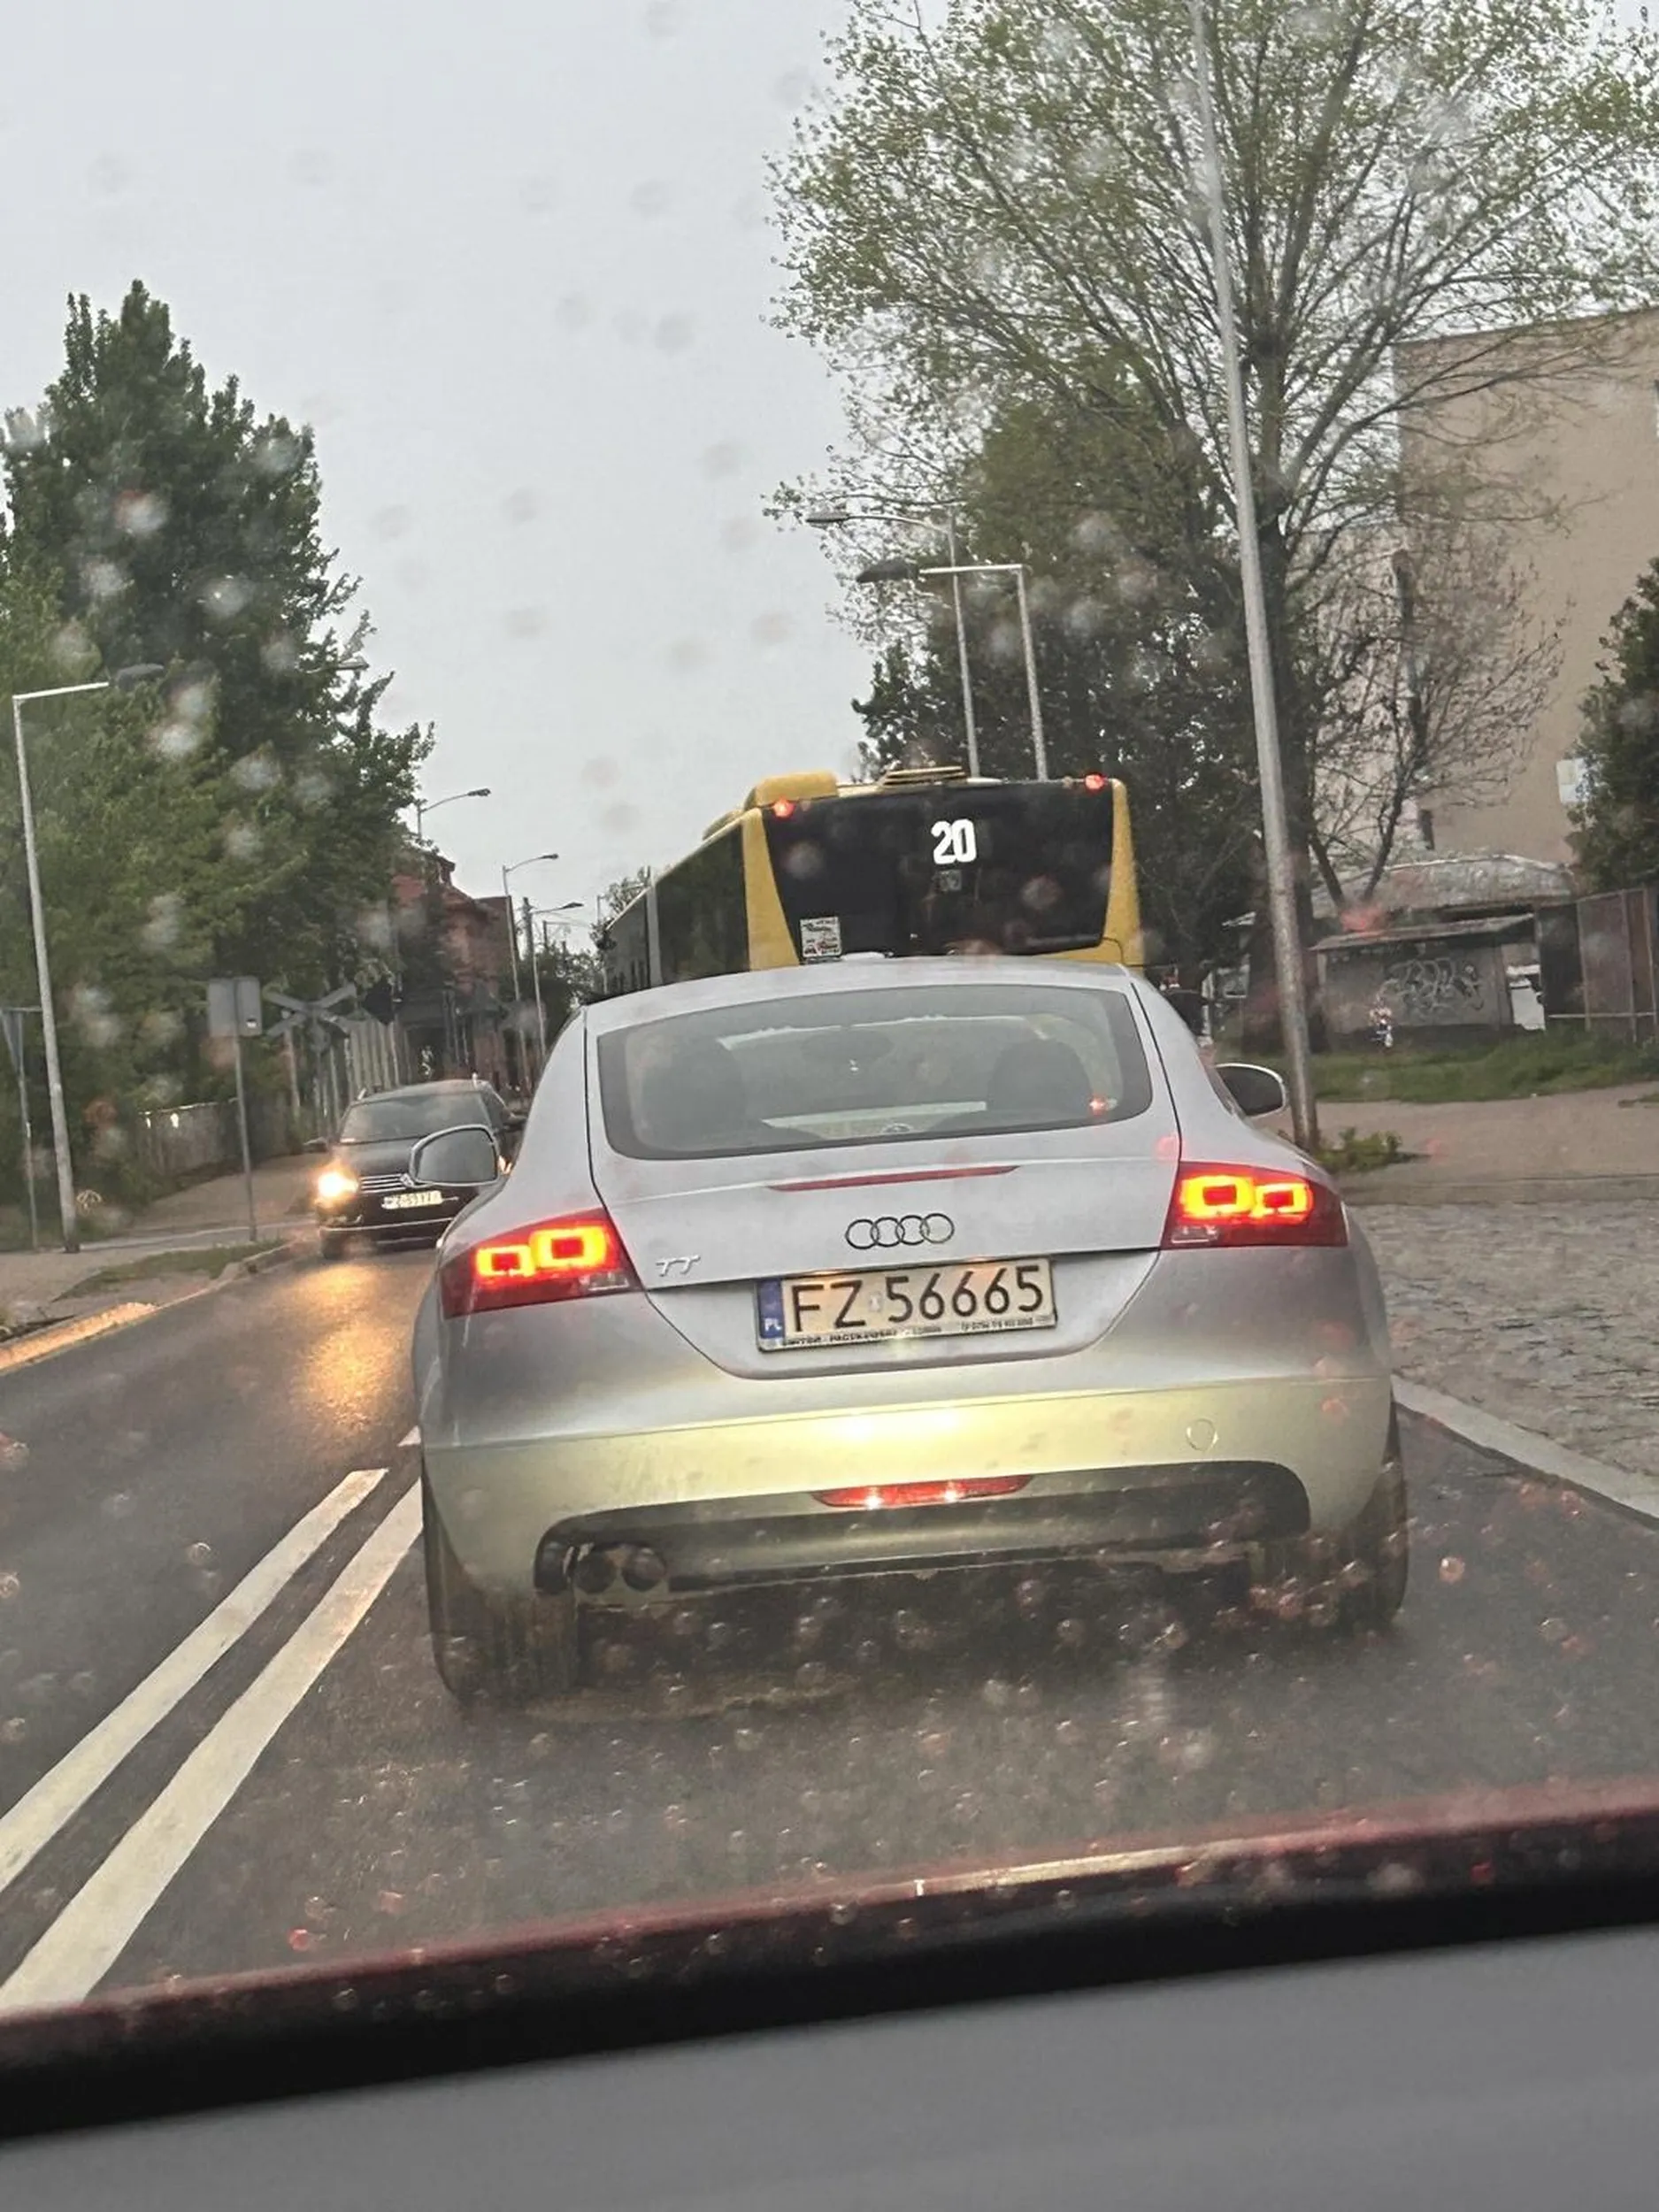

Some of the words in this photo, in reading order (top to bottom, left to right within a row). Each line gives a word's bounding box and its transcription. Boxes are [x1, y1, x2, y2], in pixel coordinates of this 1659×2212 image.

[931, 818, 977, 864] 20
[656, 1254, 701, 1277] TT
[791, 1279, 866, 1333] FZ
[886, 1264, 1043, 1323] 56665
[764, 1317, 782, 1332] PL
